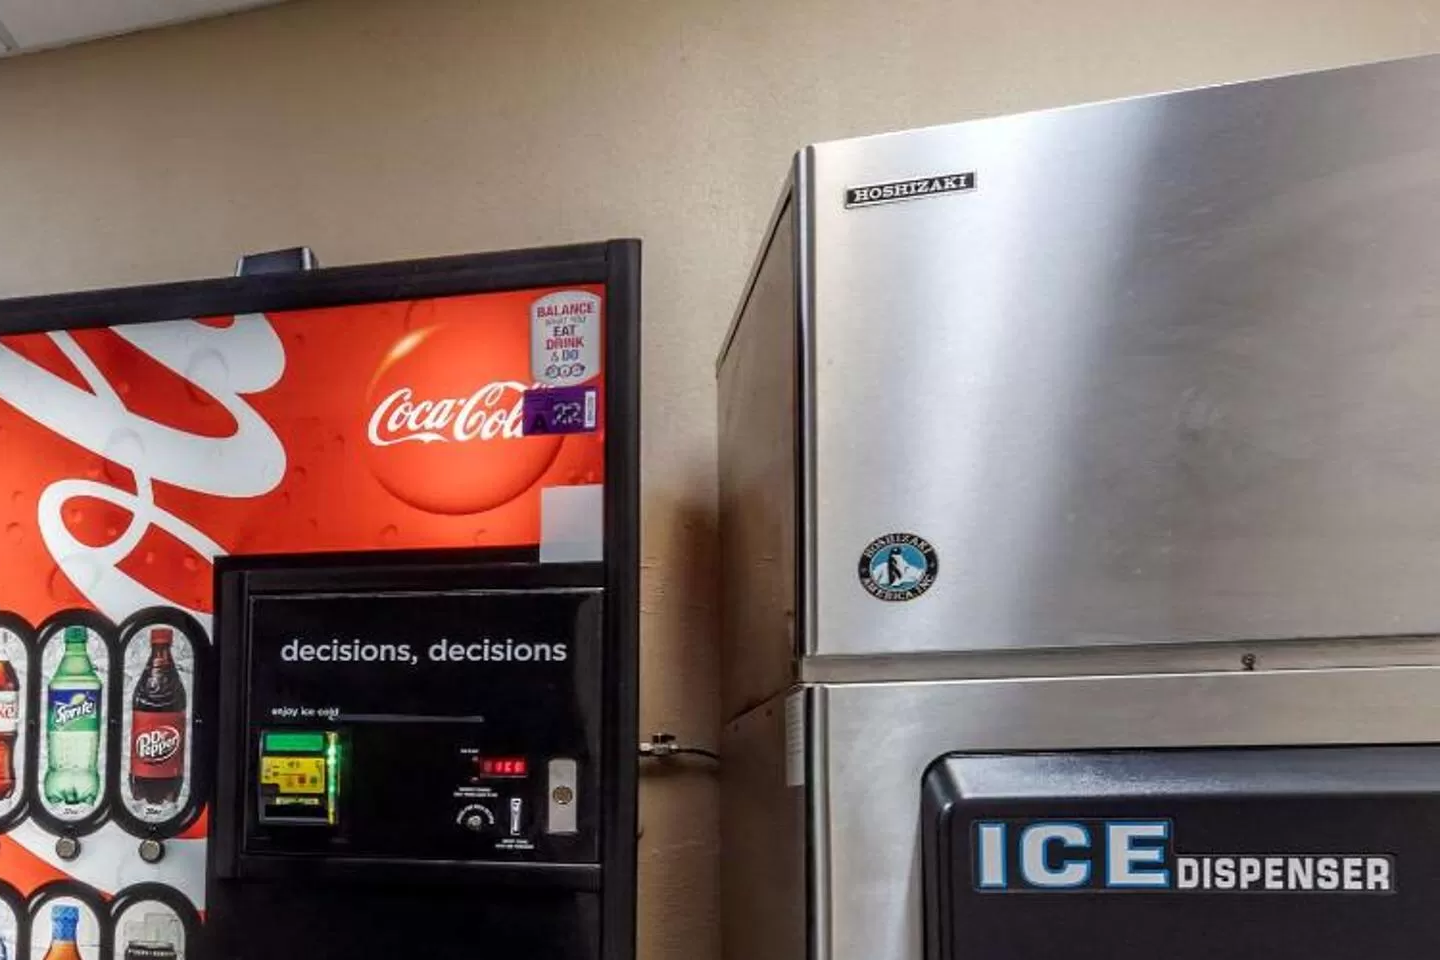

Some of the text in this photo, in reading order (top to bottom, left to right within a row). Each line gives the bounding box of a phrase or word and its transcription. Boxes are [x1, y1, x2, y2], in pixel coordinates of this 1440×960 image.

[854, 176, 967, 202] HOSHIZAKI
[536, 302, 594, 317] BALANCE
[553, 325, 576, 337] EAT
[546, 336, 585, 350] DRINK
[368, 381, 523, 446] Coca-Col
[281, 638, 567, 665] decisions, decisions
[56, 701, 94, 723] Sprite
[271, 705, 299, 717] enjoy
[976, 820, 1390, 890] ICE DISPENSER
